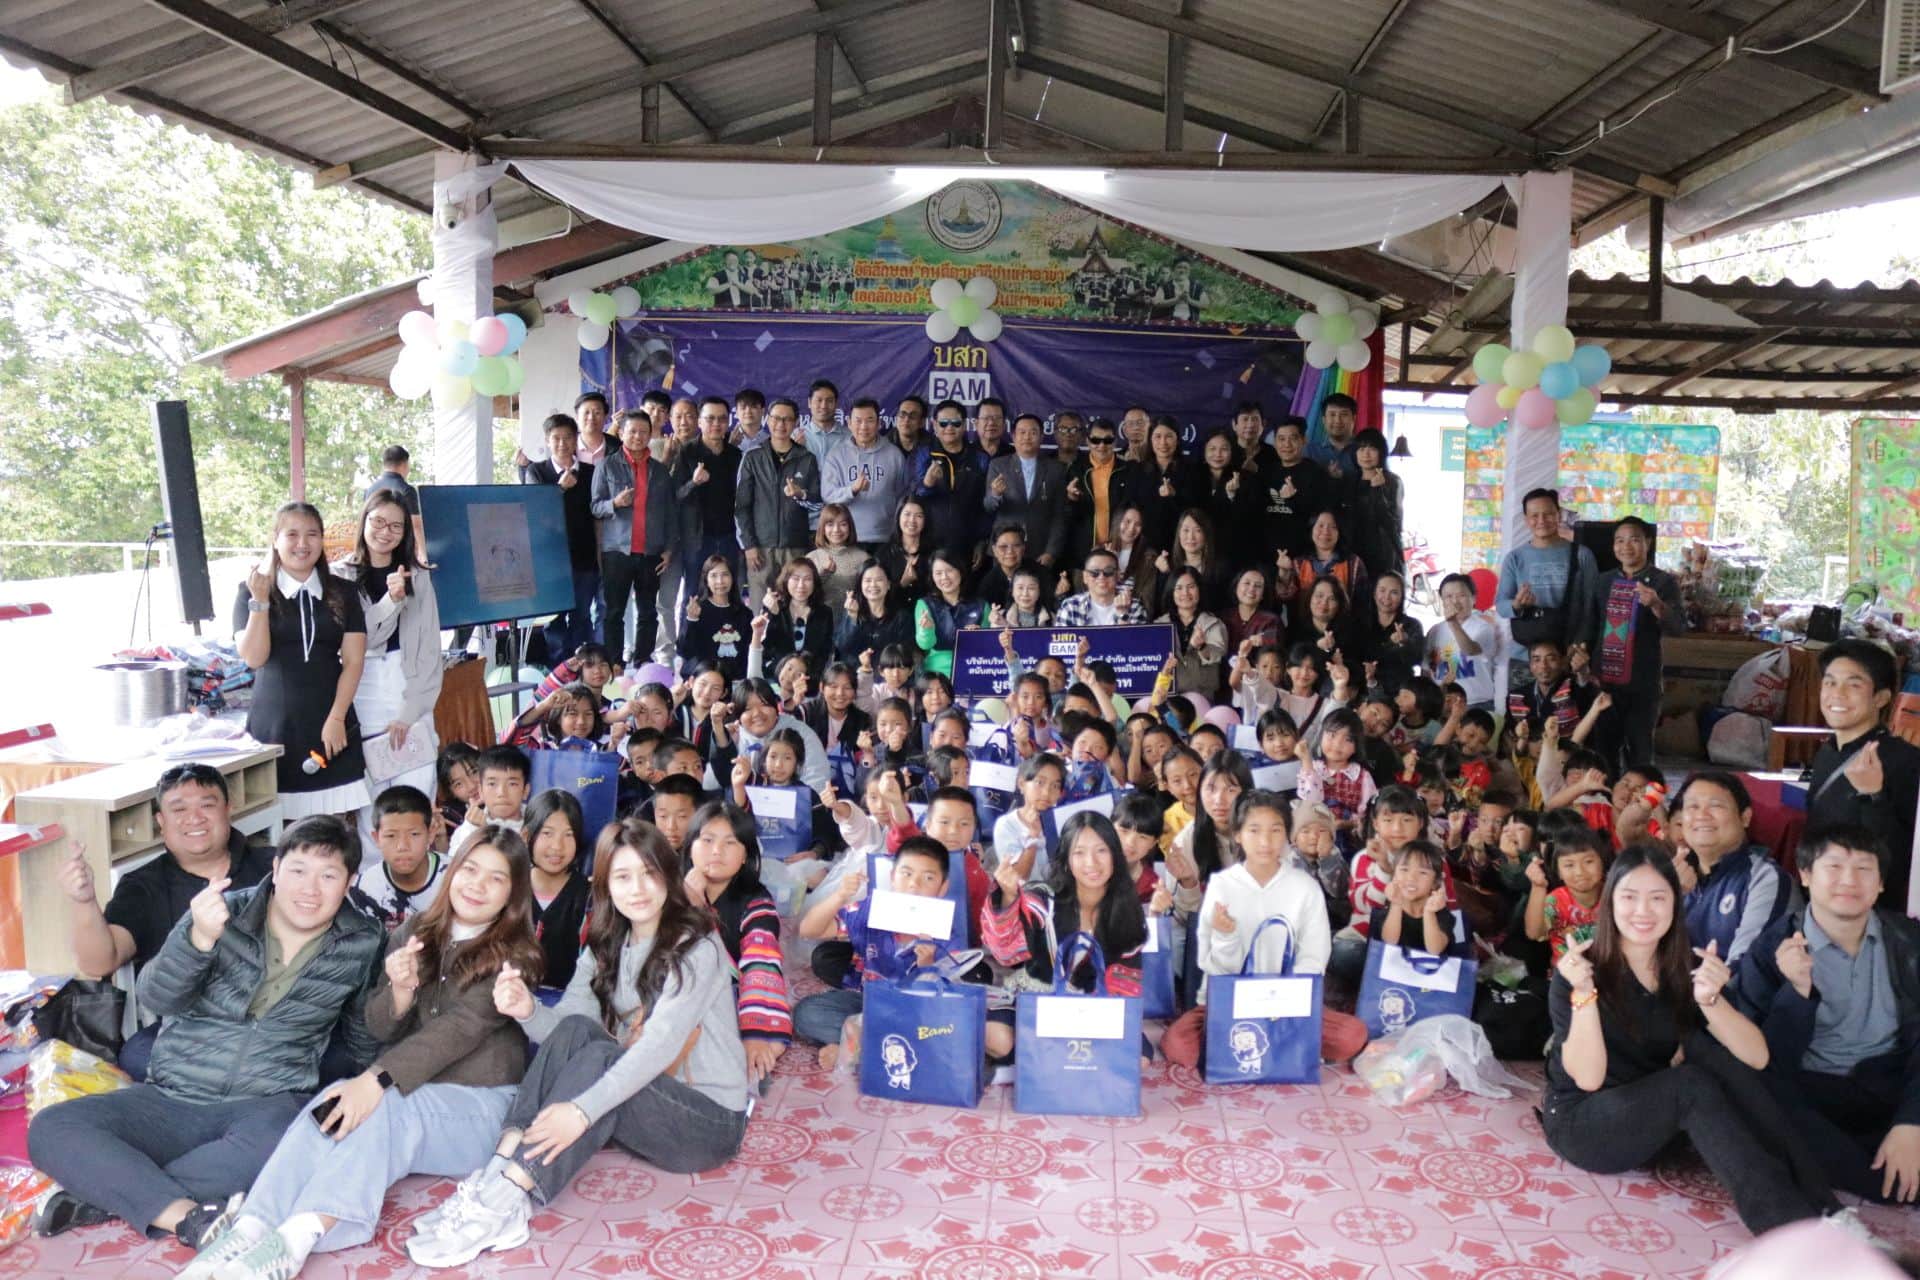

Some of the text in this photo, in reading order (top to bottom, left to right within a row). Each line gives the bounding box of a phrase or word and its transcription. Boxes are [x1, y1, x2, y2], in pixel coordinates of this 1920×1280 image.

[933, 344, 988, 369] บสก
[934, 377, 987, 401] BAM
[848, 463, 885, 482] GAP
[1051, 633, 1076, 643] บสก
[1051, 644, 1076, 654] BAM
[1066, 1039, 1092, 1062] 25
